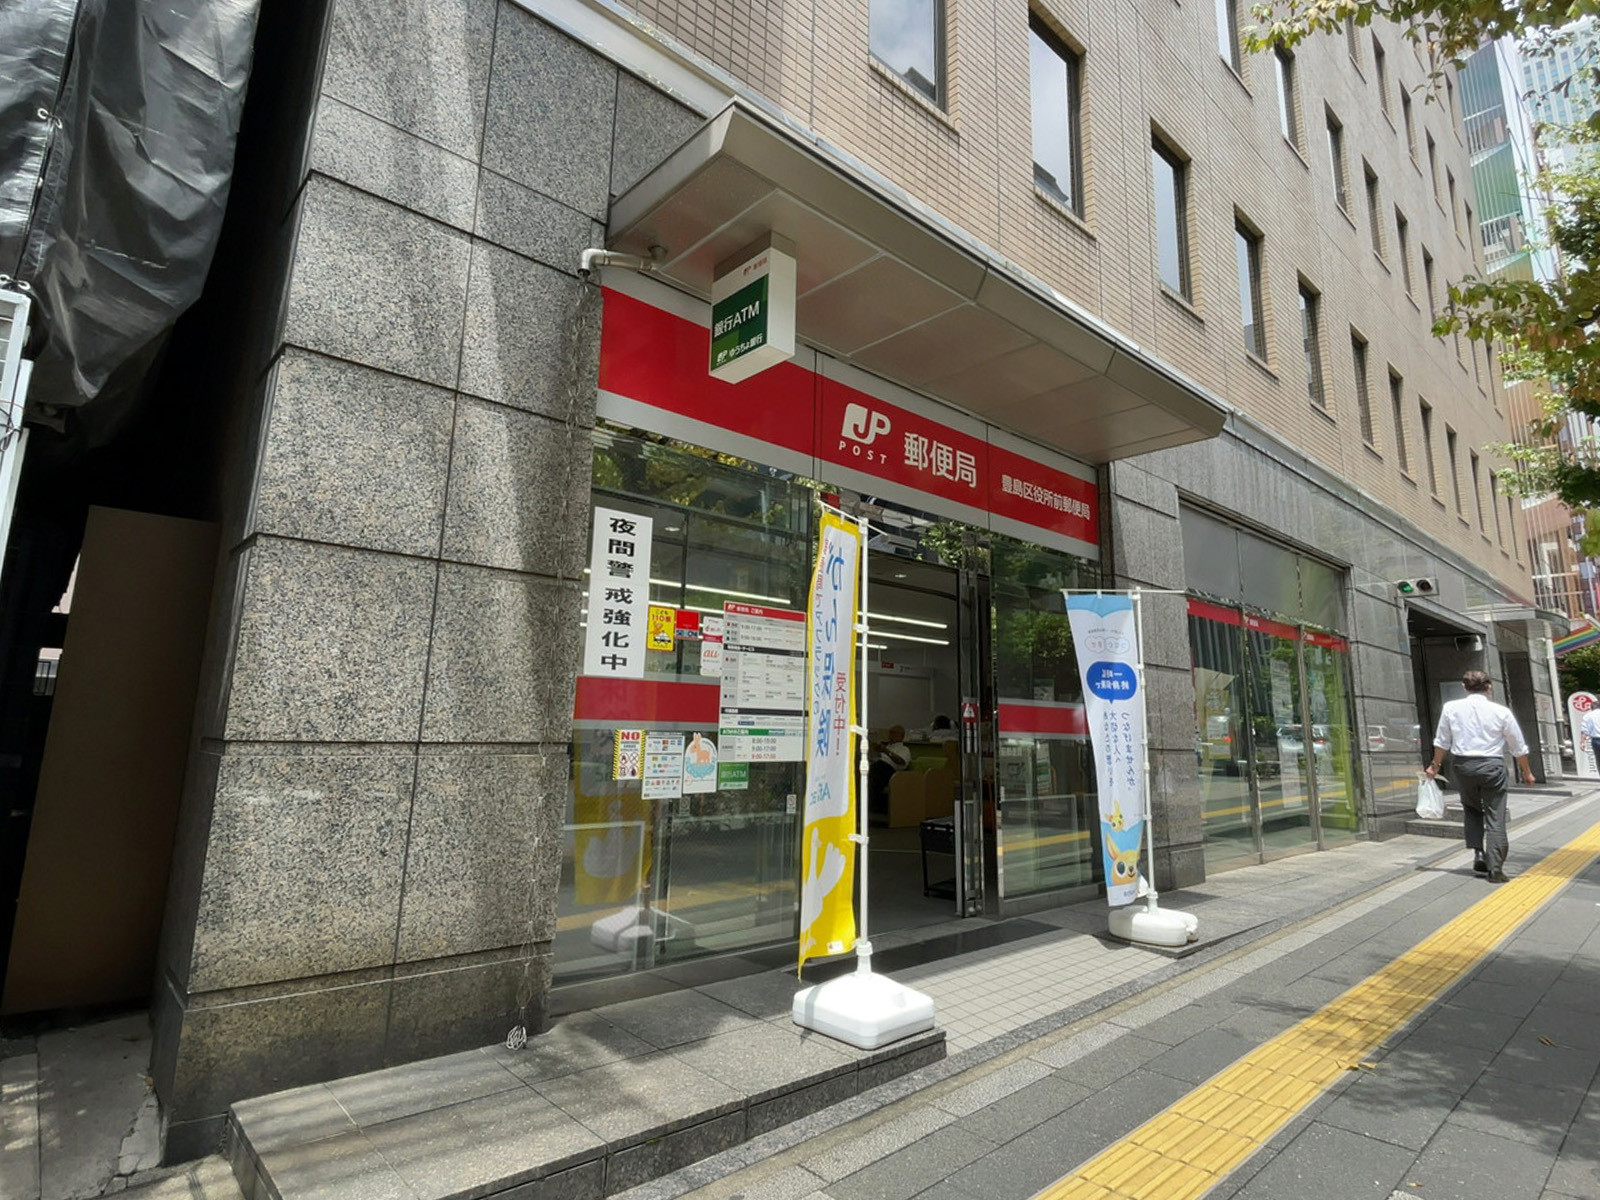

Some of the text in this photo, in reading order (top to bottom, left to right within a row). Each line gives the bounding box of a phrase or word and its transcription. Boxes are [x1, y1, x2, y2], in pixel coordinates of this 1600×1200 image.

[714, 300, 760, 338] 銀行ATM
[729, 333, 763, 358] ゆうちょ銀行
[838, 440, 888, 465] POST
[903, 432, 977, 488] 郵便局
[1001, 474, 1091, 521] 豊島区役所前郵便局
[600, 517, 637, 671] 夜間警戒強化中
[621, 731, 640, 740] NO
